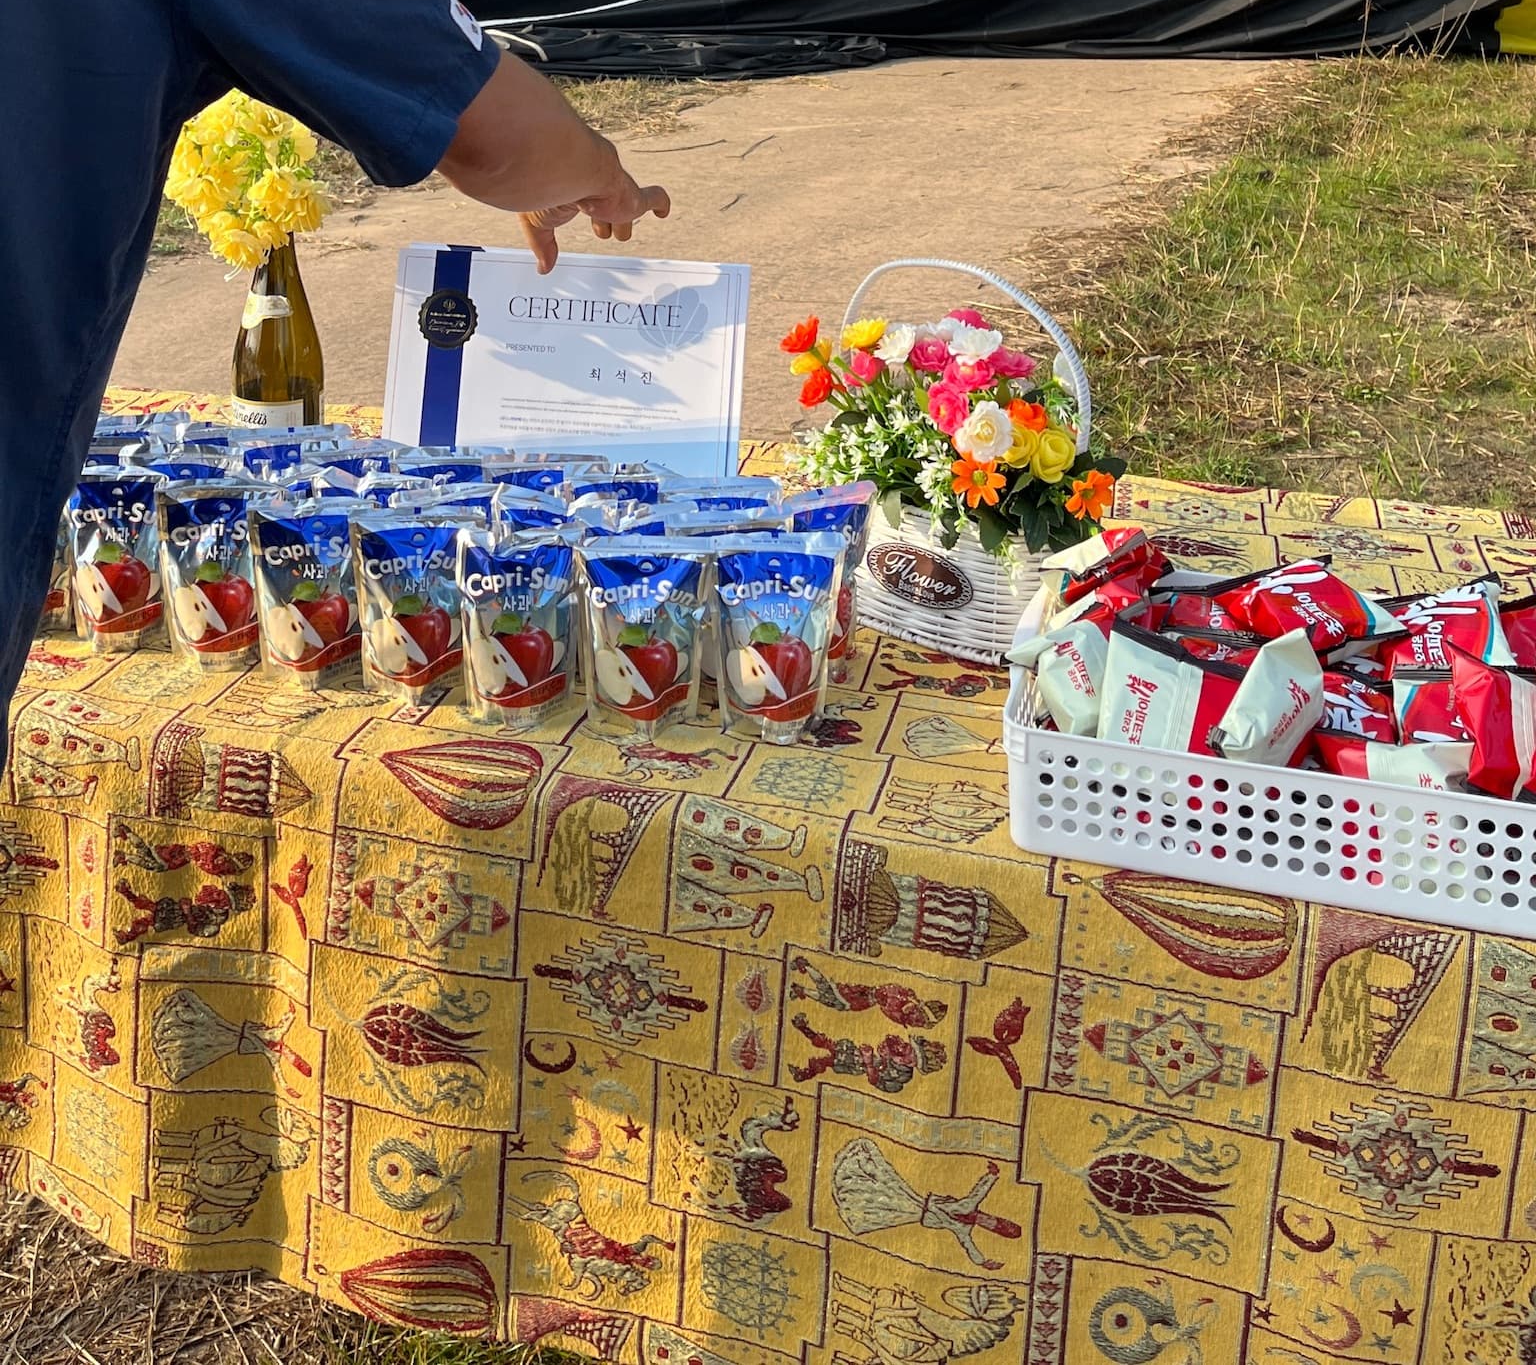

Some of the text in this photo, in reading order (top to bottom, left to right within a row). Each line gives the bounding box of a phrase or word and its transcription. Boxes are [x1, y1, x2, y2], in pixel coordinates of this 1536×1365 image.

[509, 296, 682, 327] CERTIFICATE
[505, 342, 545, 353] PRESENTED
[206, 545, 233, 561] 사과
[365, 548, 456, 580] Capri-Su
[302, 563, 329, 580] 사과
[466, 566, 569, 597] Capri-Sun
[883, 551, 957, 595] Flower
[404, 579, 429, 594] 사과
[592, 578, 695, 609] Capri-Sun
[720, 573, 828, 607] Capri-Sun
[503, 594, 532, 611] 사과
[762, 603, 790, 621] 사과
[630, 607, 656, 624] 사과
[1412, 635, 1425, 662] 오리온
[1121, 709, 1134, 734] 오리온
